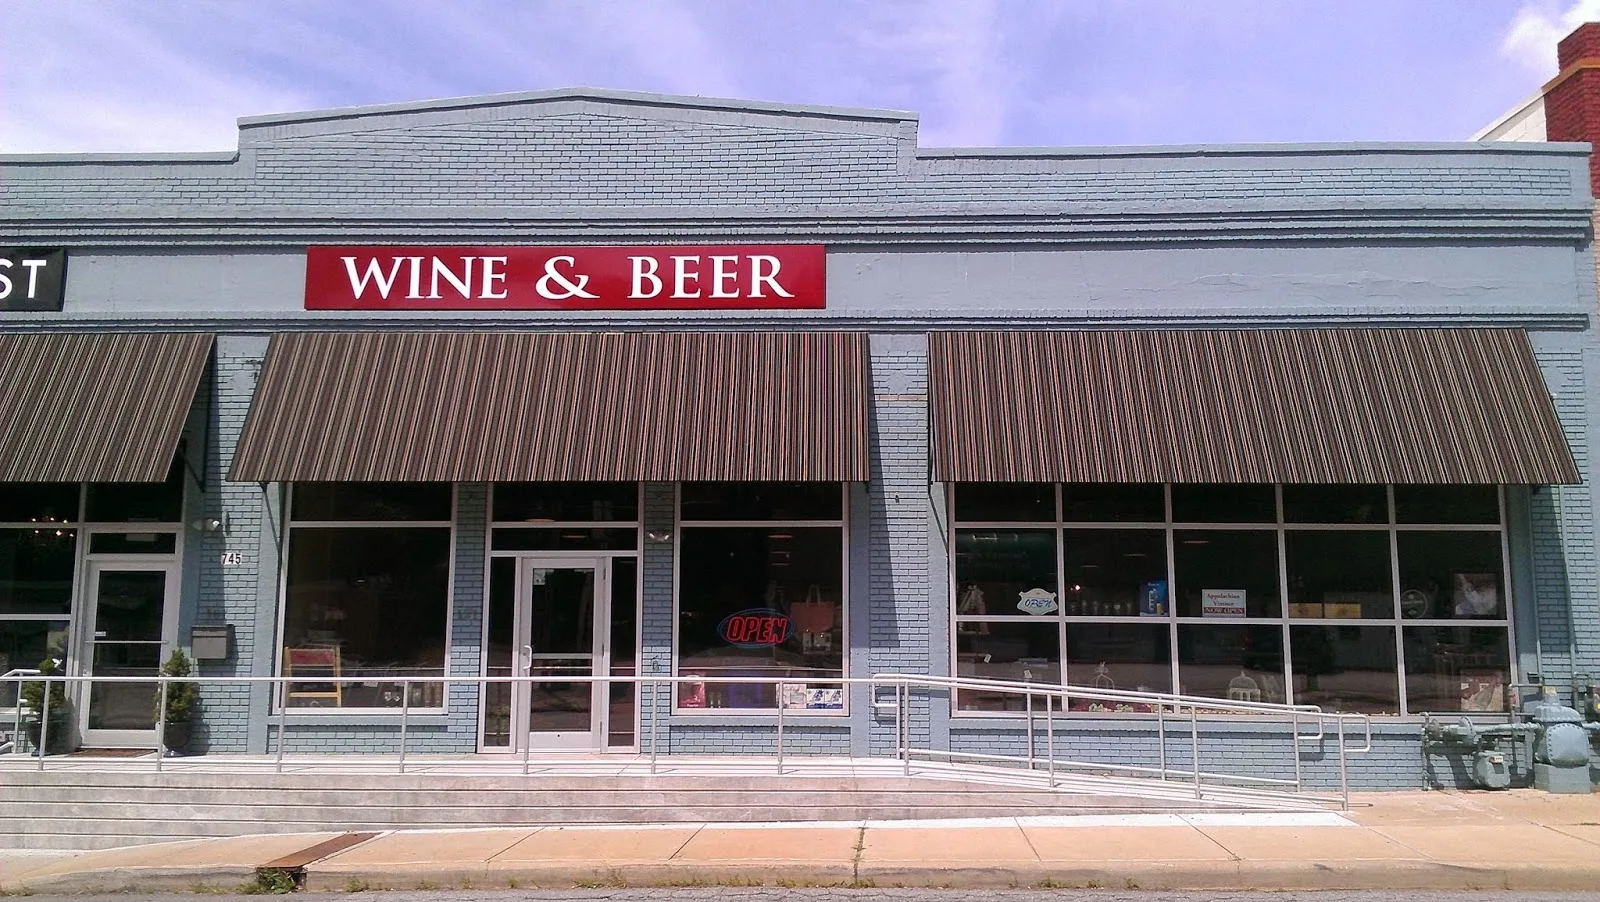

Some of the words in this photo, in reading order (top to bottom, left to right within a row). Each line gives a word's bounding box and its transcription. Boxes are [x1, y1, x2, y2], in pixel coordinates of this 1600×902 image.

[340, 256, 508, 299] WINE
[535, 255, 600, 299] &
[627, 255, 795, 299] BEER
[222, 553, 241, 564] 745
[1024, 598, 1052, 608] OPEN
[727, 616, 788, 643] OPEN
